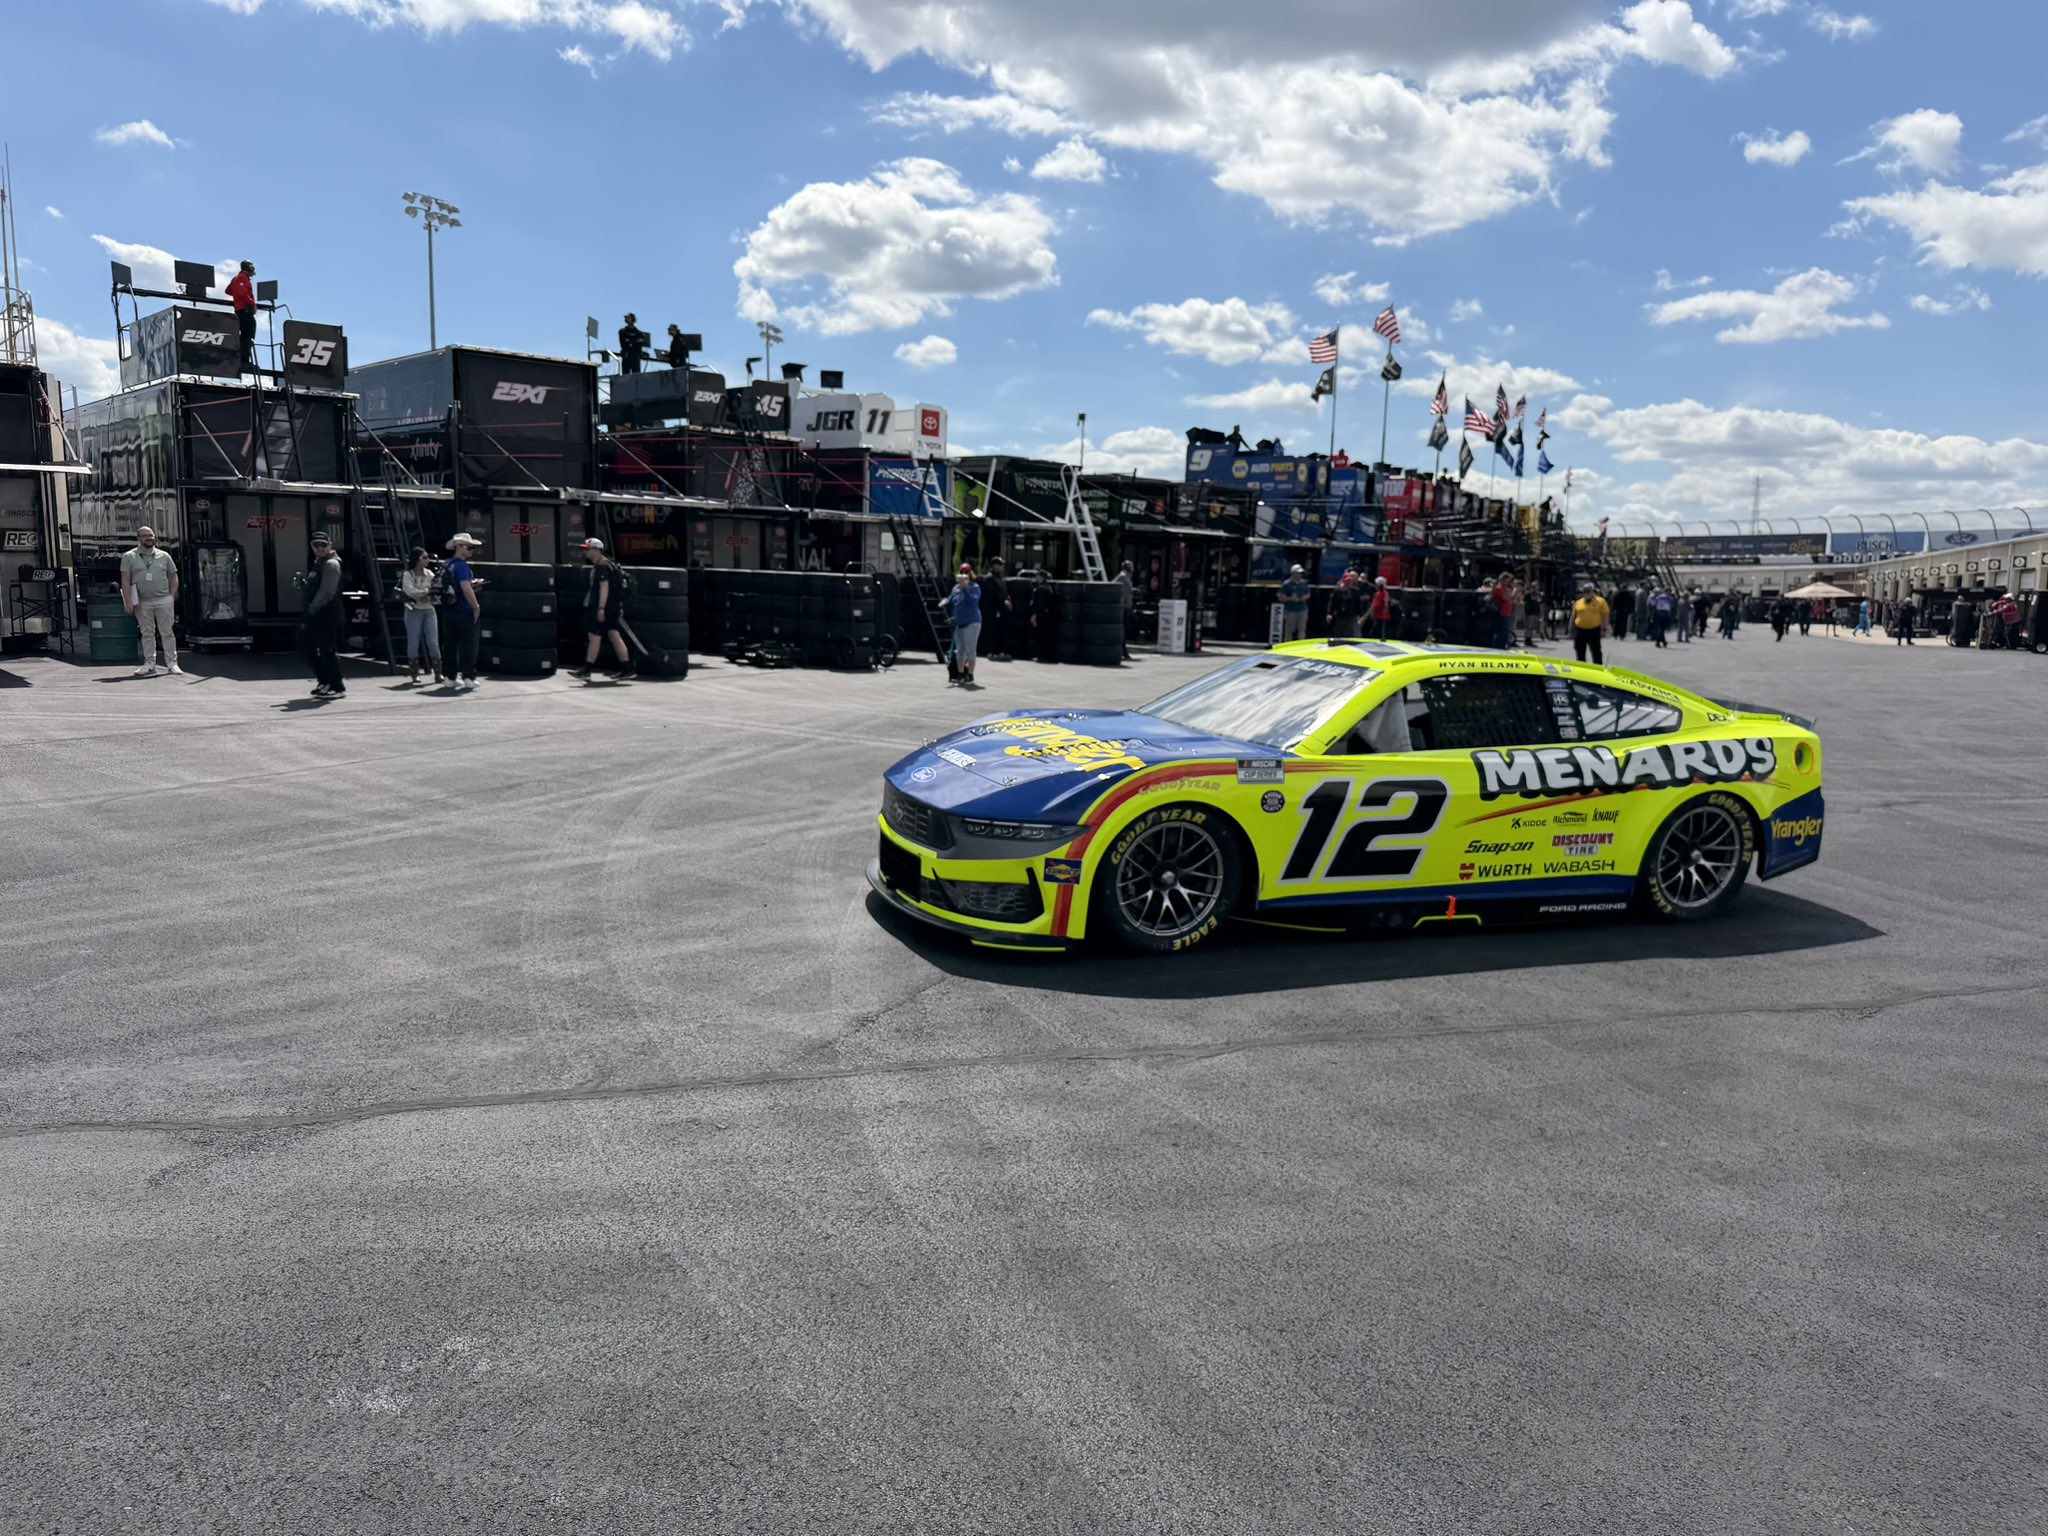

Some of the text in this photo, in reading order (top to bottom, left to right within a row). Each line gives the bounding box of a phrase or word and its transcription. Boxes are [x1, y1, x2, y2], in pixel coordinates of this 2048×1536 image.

[290, 338, 336, 366] 35
[755, 394, 785, 417] 45
[806, 410, 854, 432] JGR
[866, 409, 891, 434] 11
[1188, 449, 1213, 472] 9
[1857, 540, 1892, 551] BUSCH
[1481, 661, 1530, 669] BLANEY
[1472, 737, 1776, 800] MENARDS
[1553, 813, 1588, 825] Richmond
[1277, 775, 1452, 886] 12
[1464, 840, 1535, 856] Snap-on
[1552, 833, 1614, 847] DISCOUNT
[1567, 846, 1595, 855] TIRE
[1478, 863, 1533, 878] WÜRTH
[1543, 860, 1616, 874] WABASH
[1539, 902, 1628, 913] FORD RACING
[1172, 915, 1218, 952] EAGLE
